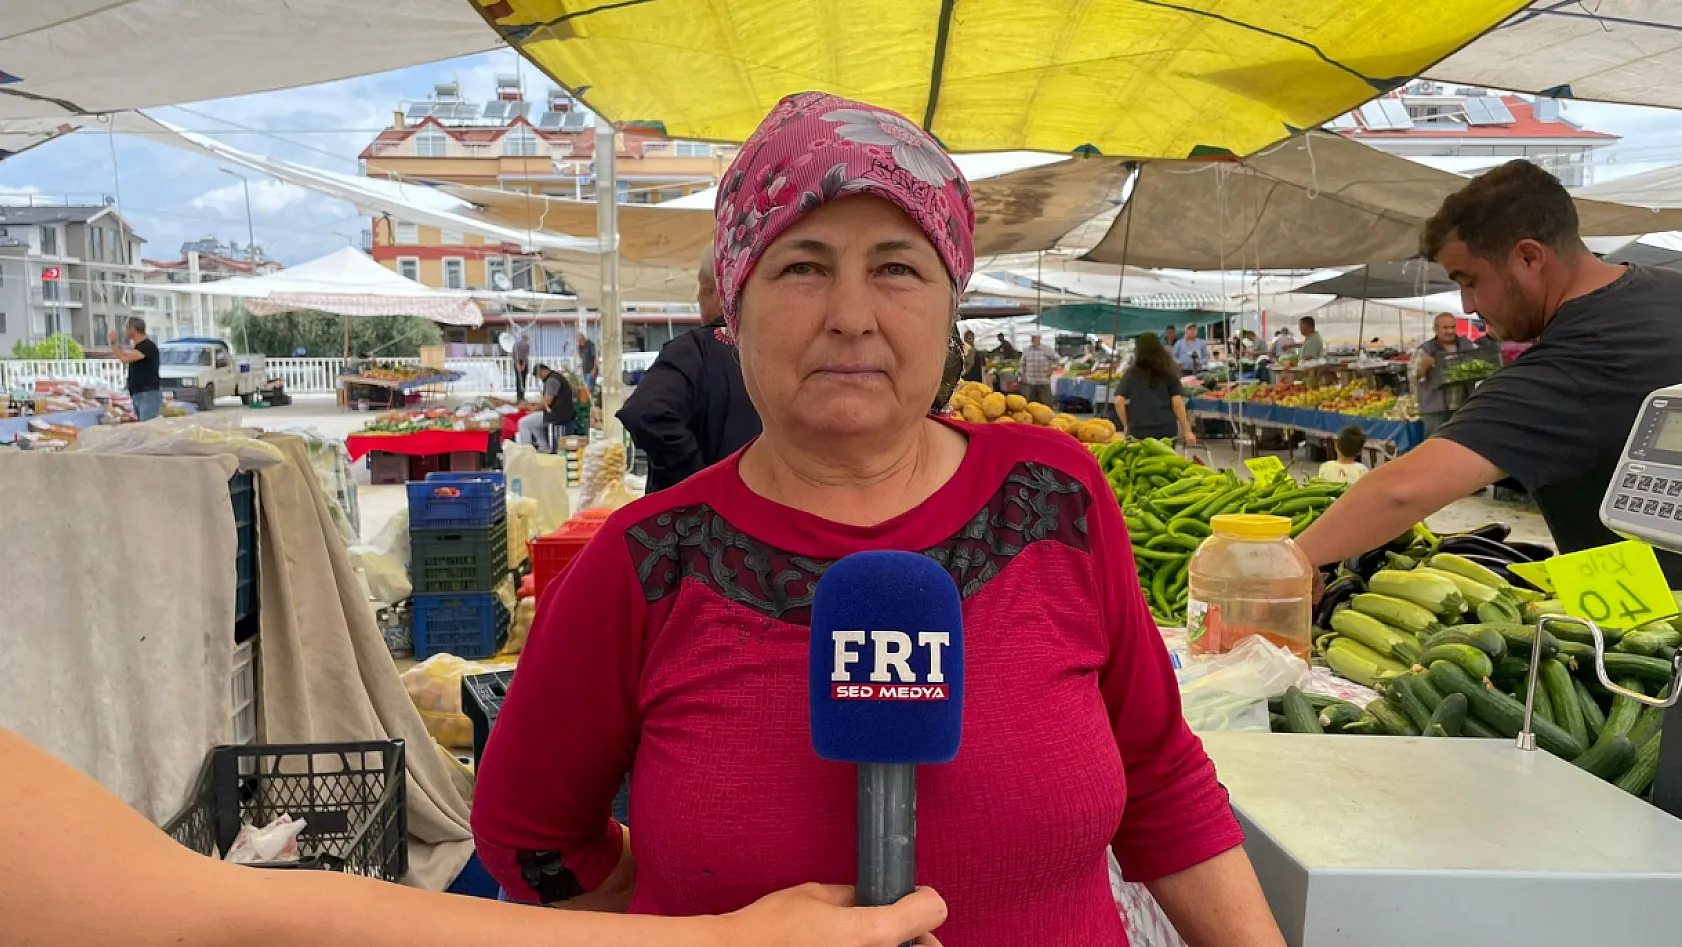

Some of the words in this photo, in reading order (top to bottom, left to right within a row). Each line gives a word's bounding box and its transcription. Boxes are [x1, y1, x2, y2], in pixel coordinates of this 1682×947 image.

[831, 630, 949, 682] FRT
[836, 685, 873, 698] SED
[878, 686, 945, 698] MEDYA
